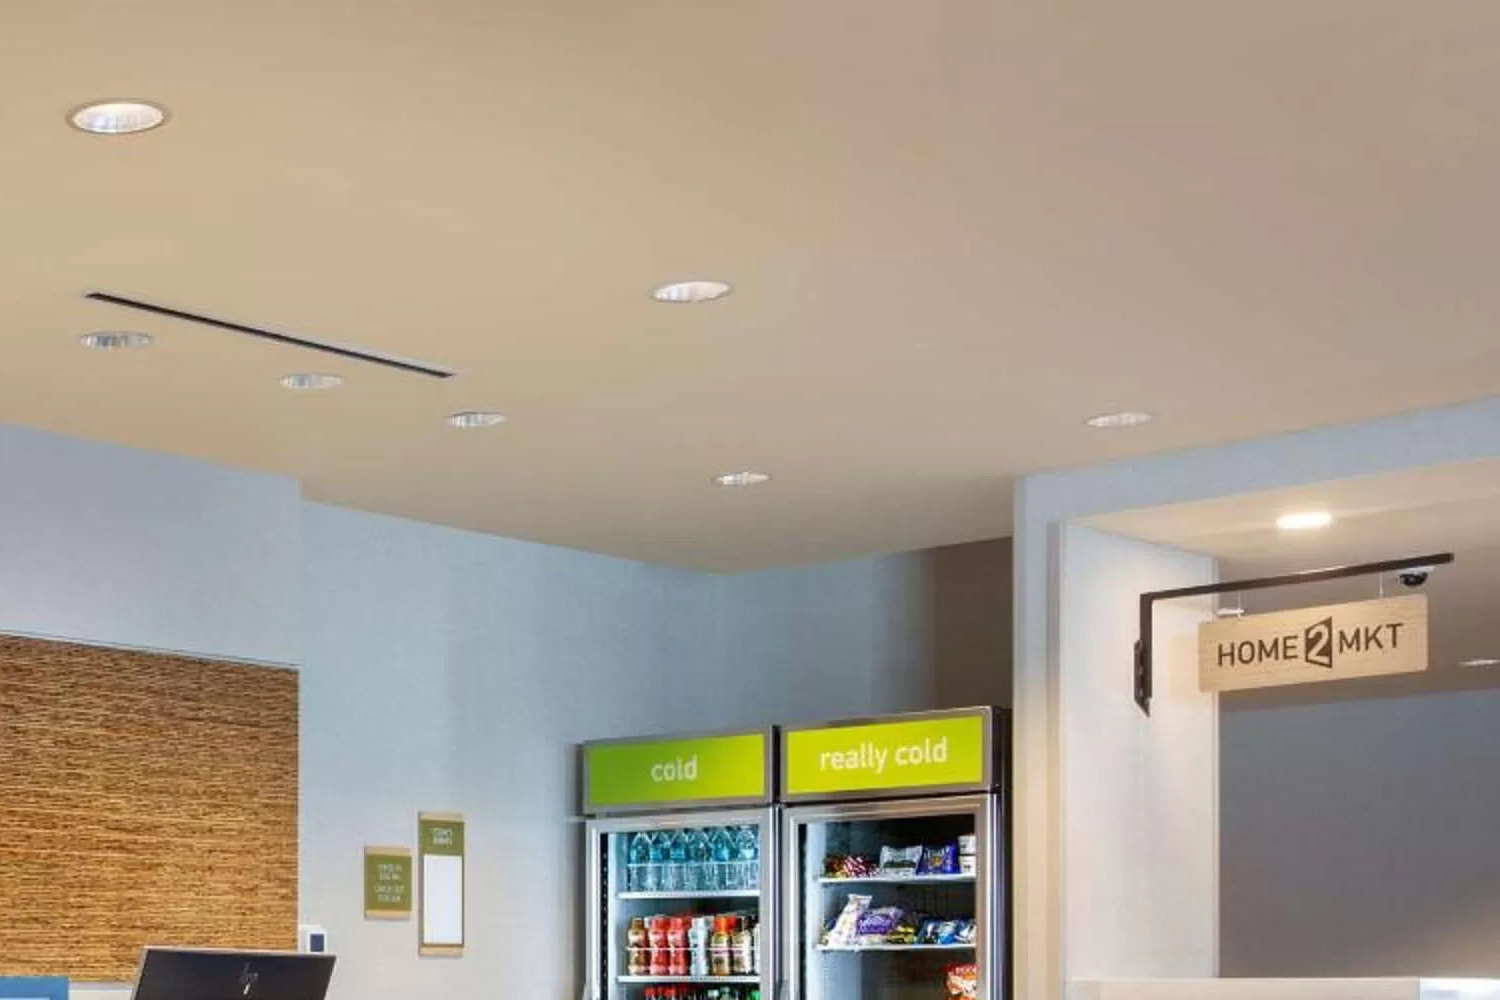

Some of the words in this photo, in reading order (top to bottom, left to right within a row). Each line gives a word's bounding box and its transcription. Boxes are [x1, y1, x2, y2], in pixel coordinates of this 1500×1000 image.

[1338, 622, 1405, 654] MKT
[651, 754, 698, 783] cold
[819, 742, 888, 775] really
[895, 737, 949, 767] cold
